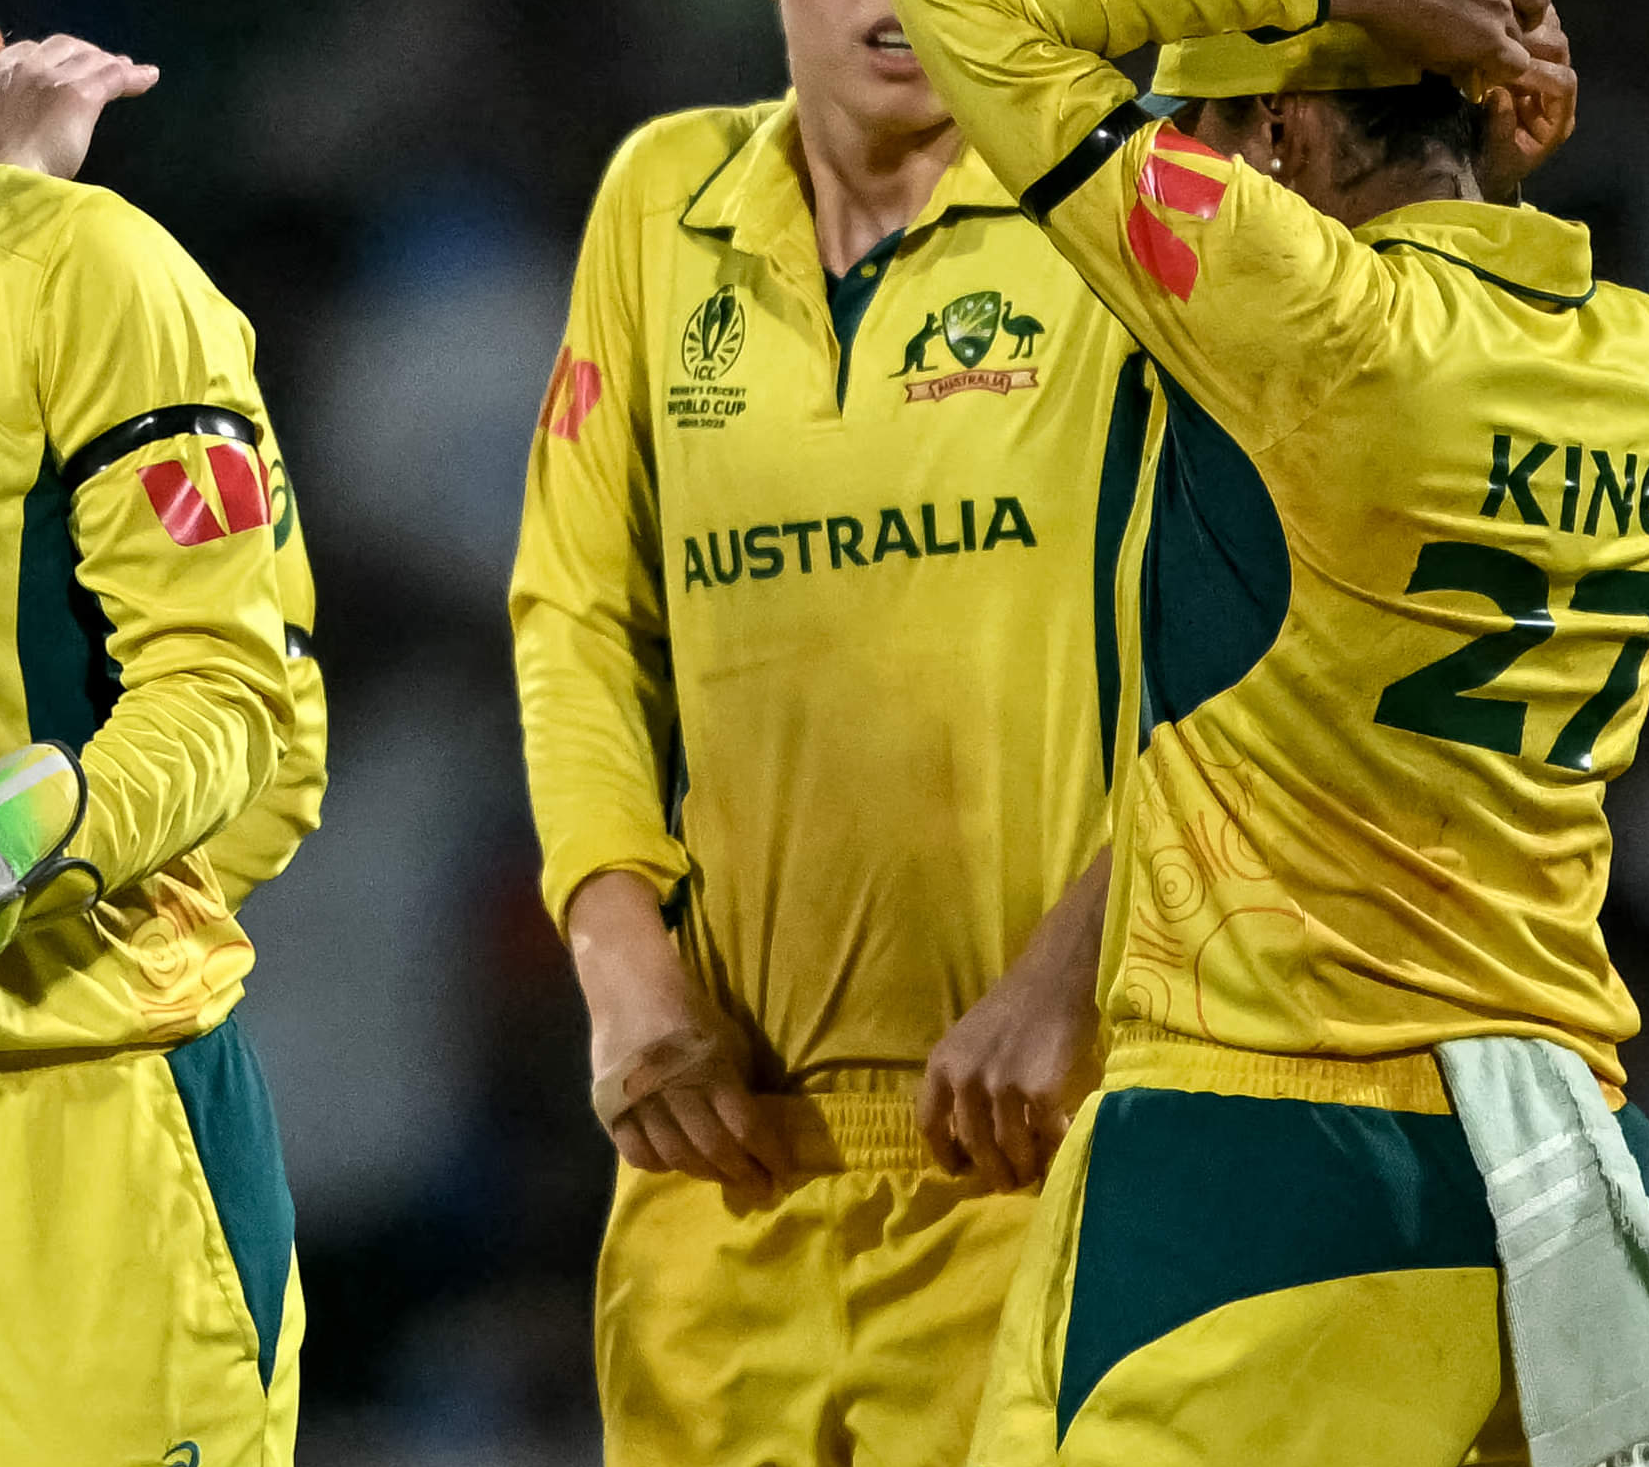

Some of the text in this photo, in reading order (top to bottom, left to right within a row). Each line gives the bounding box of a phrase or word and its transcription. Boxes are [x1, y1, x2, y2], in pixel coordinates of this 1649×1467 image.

[693, 365, 716, 381] ICC
[713, 400, 746, 416] CUP
[684, 496, 1037, 593] AUSTRALIA
